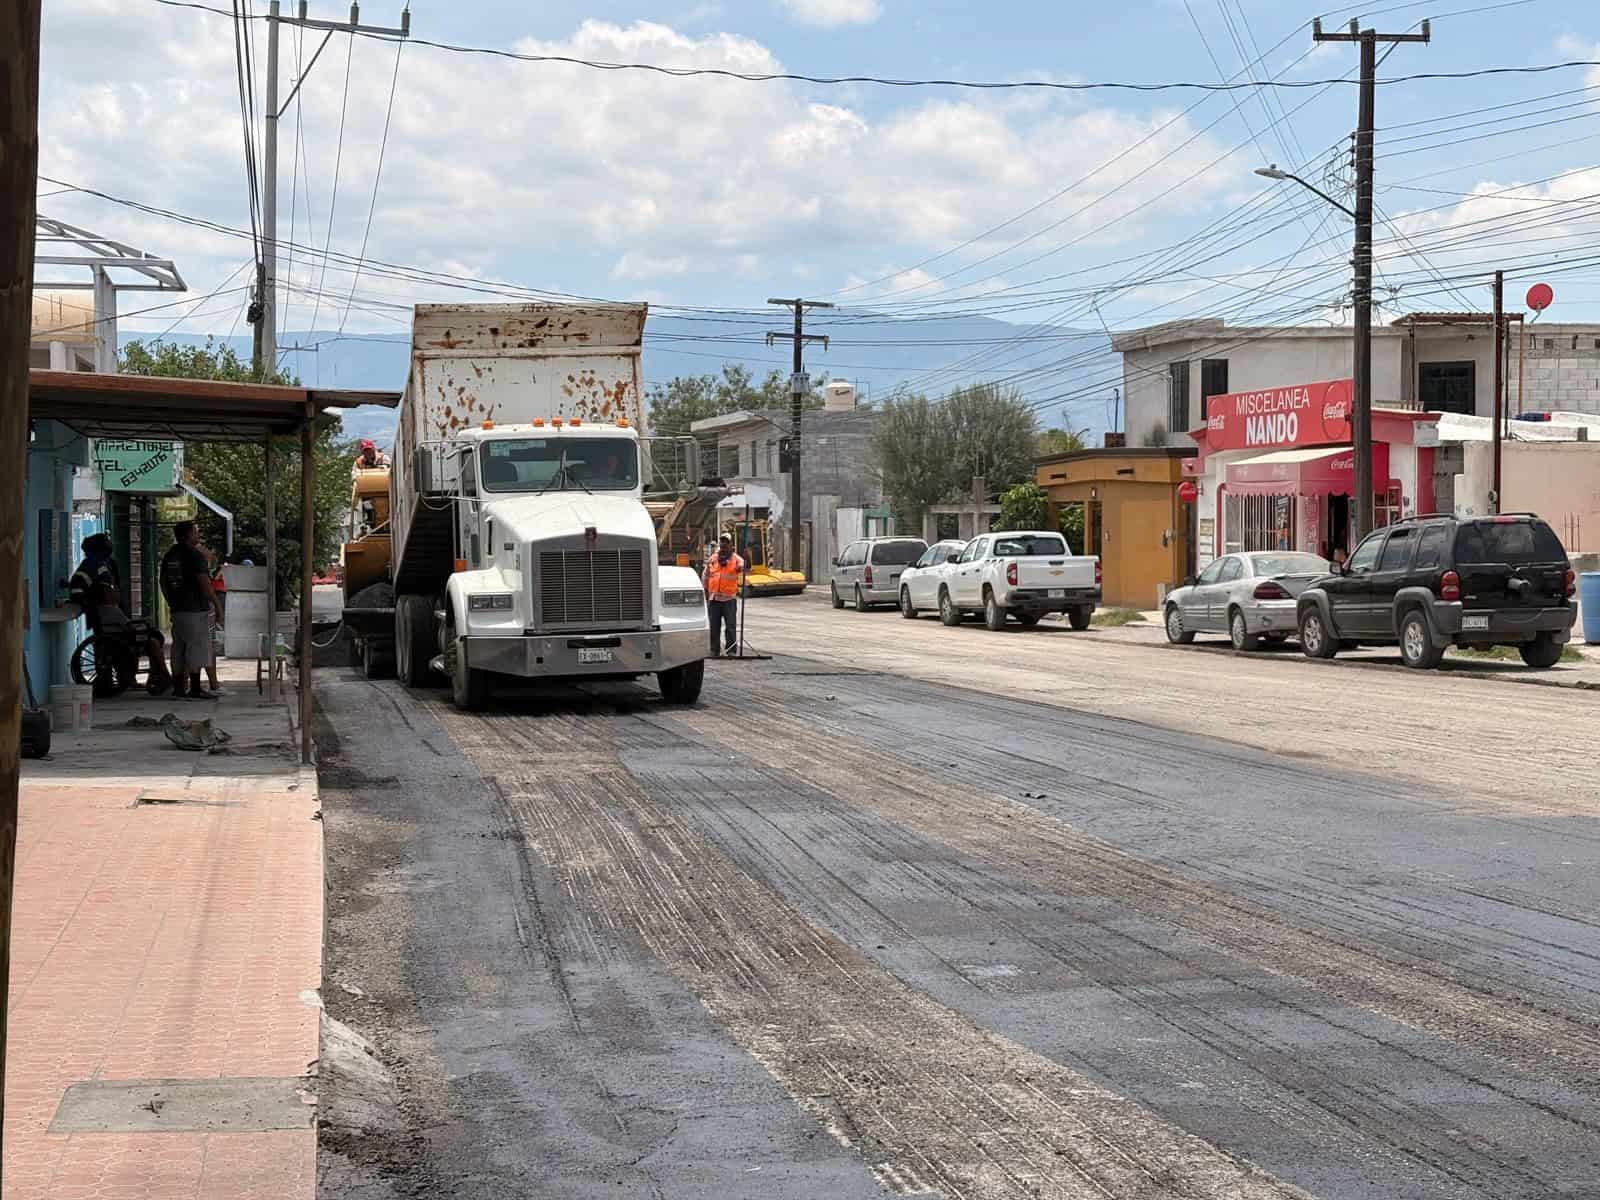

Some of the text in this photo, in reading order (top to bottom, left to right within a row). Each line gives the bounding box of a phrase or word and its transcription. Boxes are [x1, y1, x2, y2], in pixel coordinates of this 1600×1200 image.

[1235, 388, 1311, 416] MISCELANEA
[1246, 412, 1298, 445] NANDO
[94, 460, 127, 472] TEL.
[121, 452, 168, 487] 6342076
